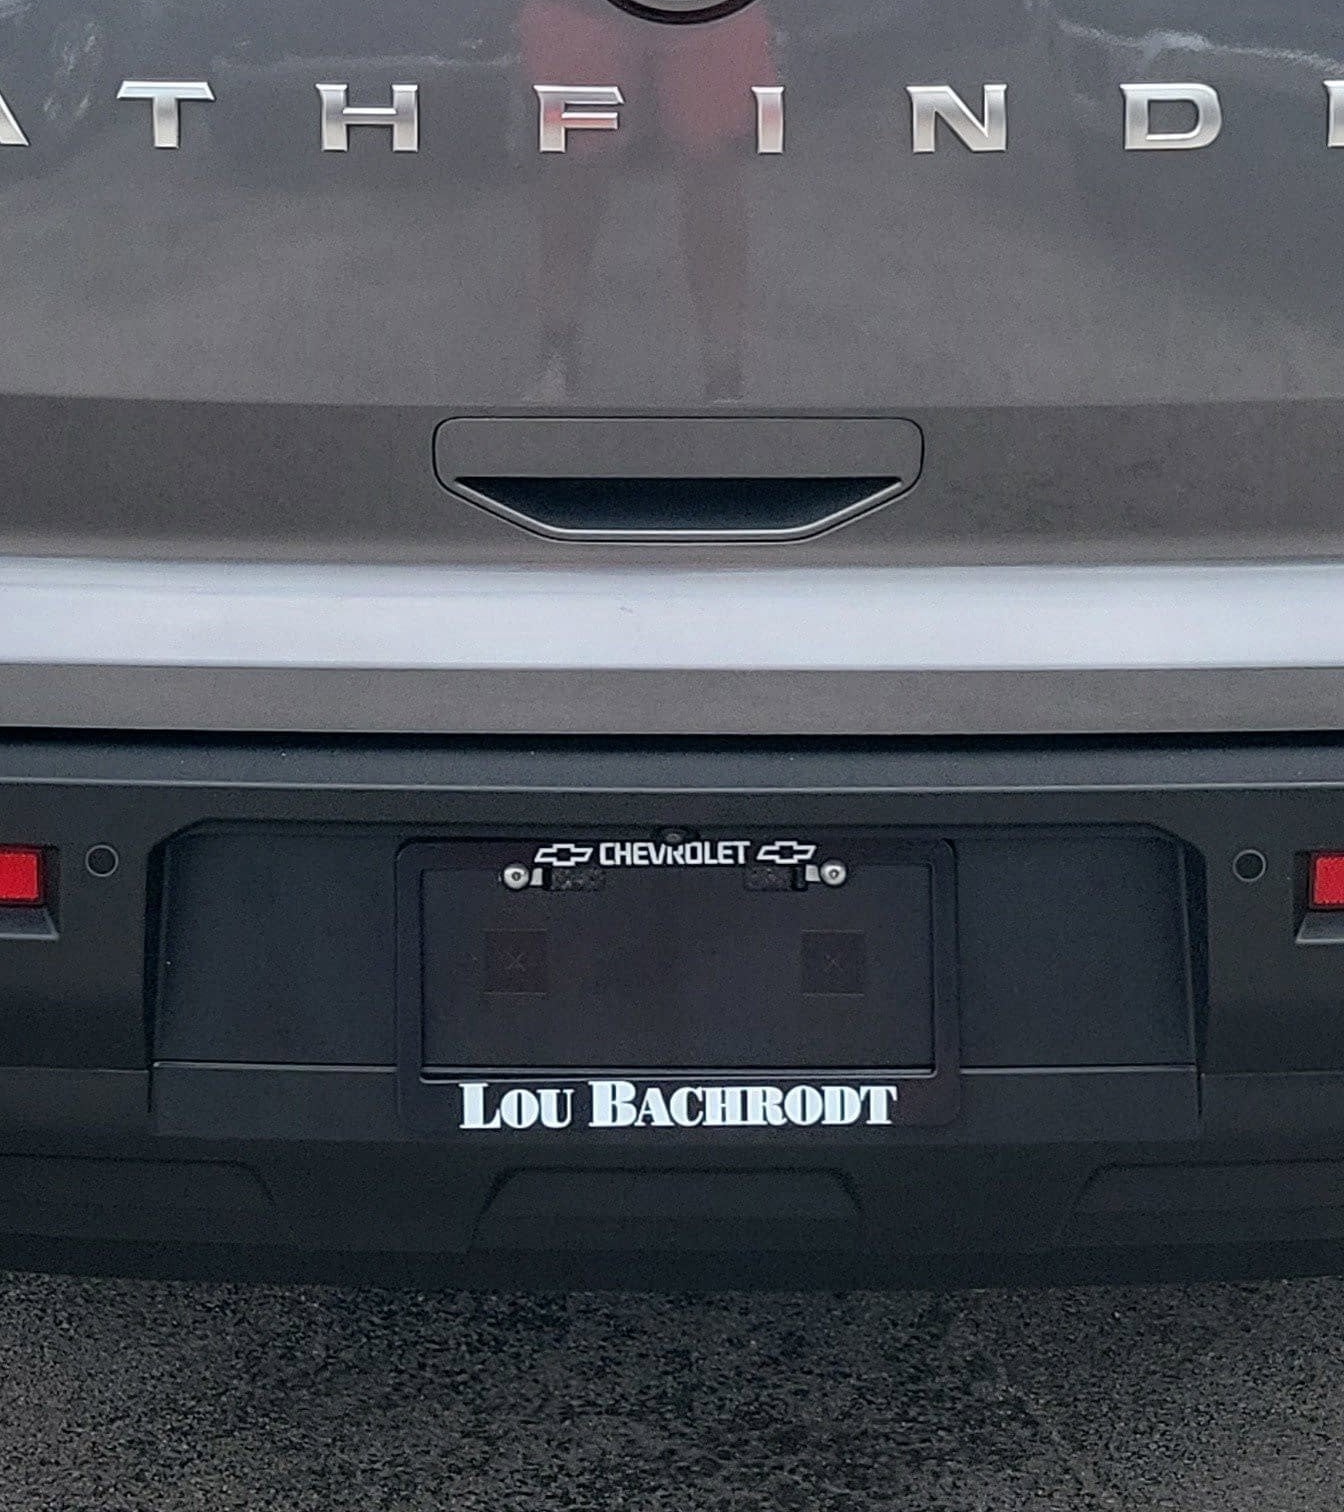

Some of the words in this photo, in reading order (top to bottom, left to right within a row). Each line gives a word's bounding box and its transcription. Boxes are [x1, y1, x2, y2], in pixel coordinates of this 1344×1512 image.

[598, 839, 751, 866] CHEVROLET
[458, 1081, 575, 1130] LOU
[588, 1080, 898, 1128] BACHRODT
